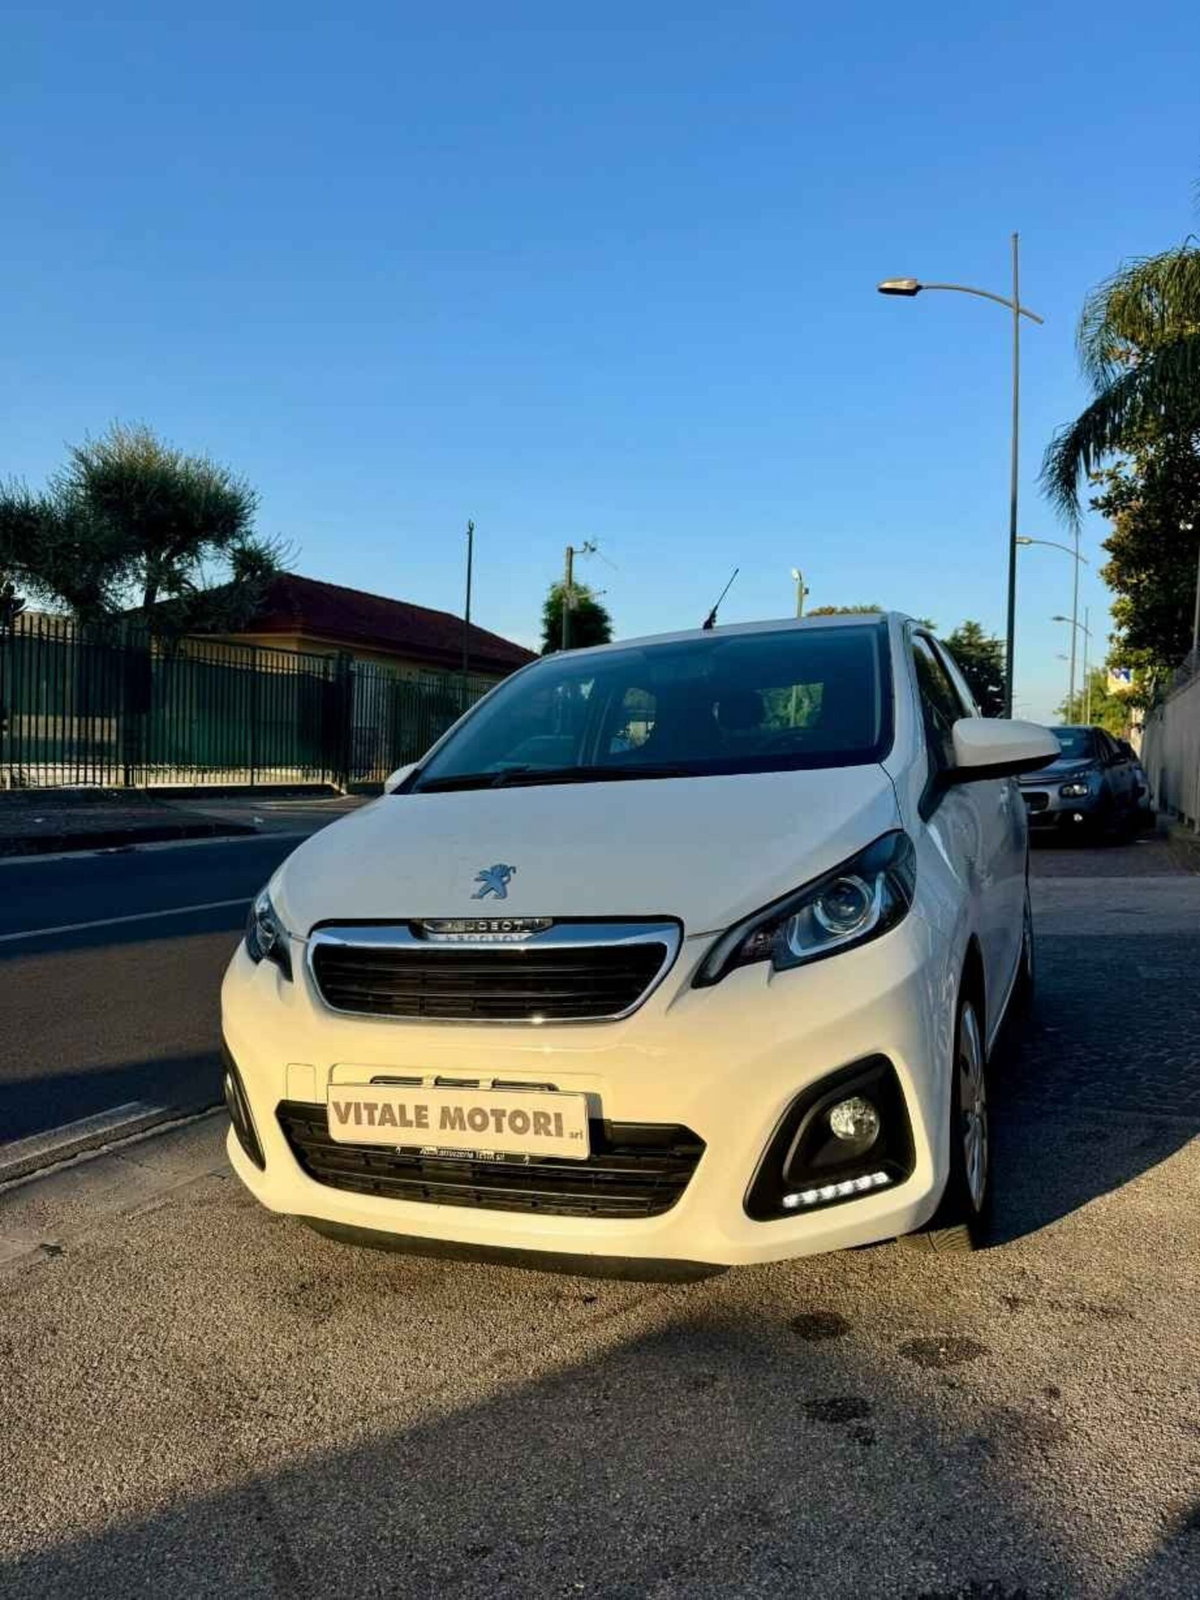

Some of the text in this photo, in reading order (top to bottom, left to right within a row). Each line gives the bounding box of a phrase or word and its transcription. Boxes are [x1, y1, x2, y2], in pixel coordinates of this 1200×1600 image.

[332, 1101, 584, 1140] VITALE MOTORI srl
